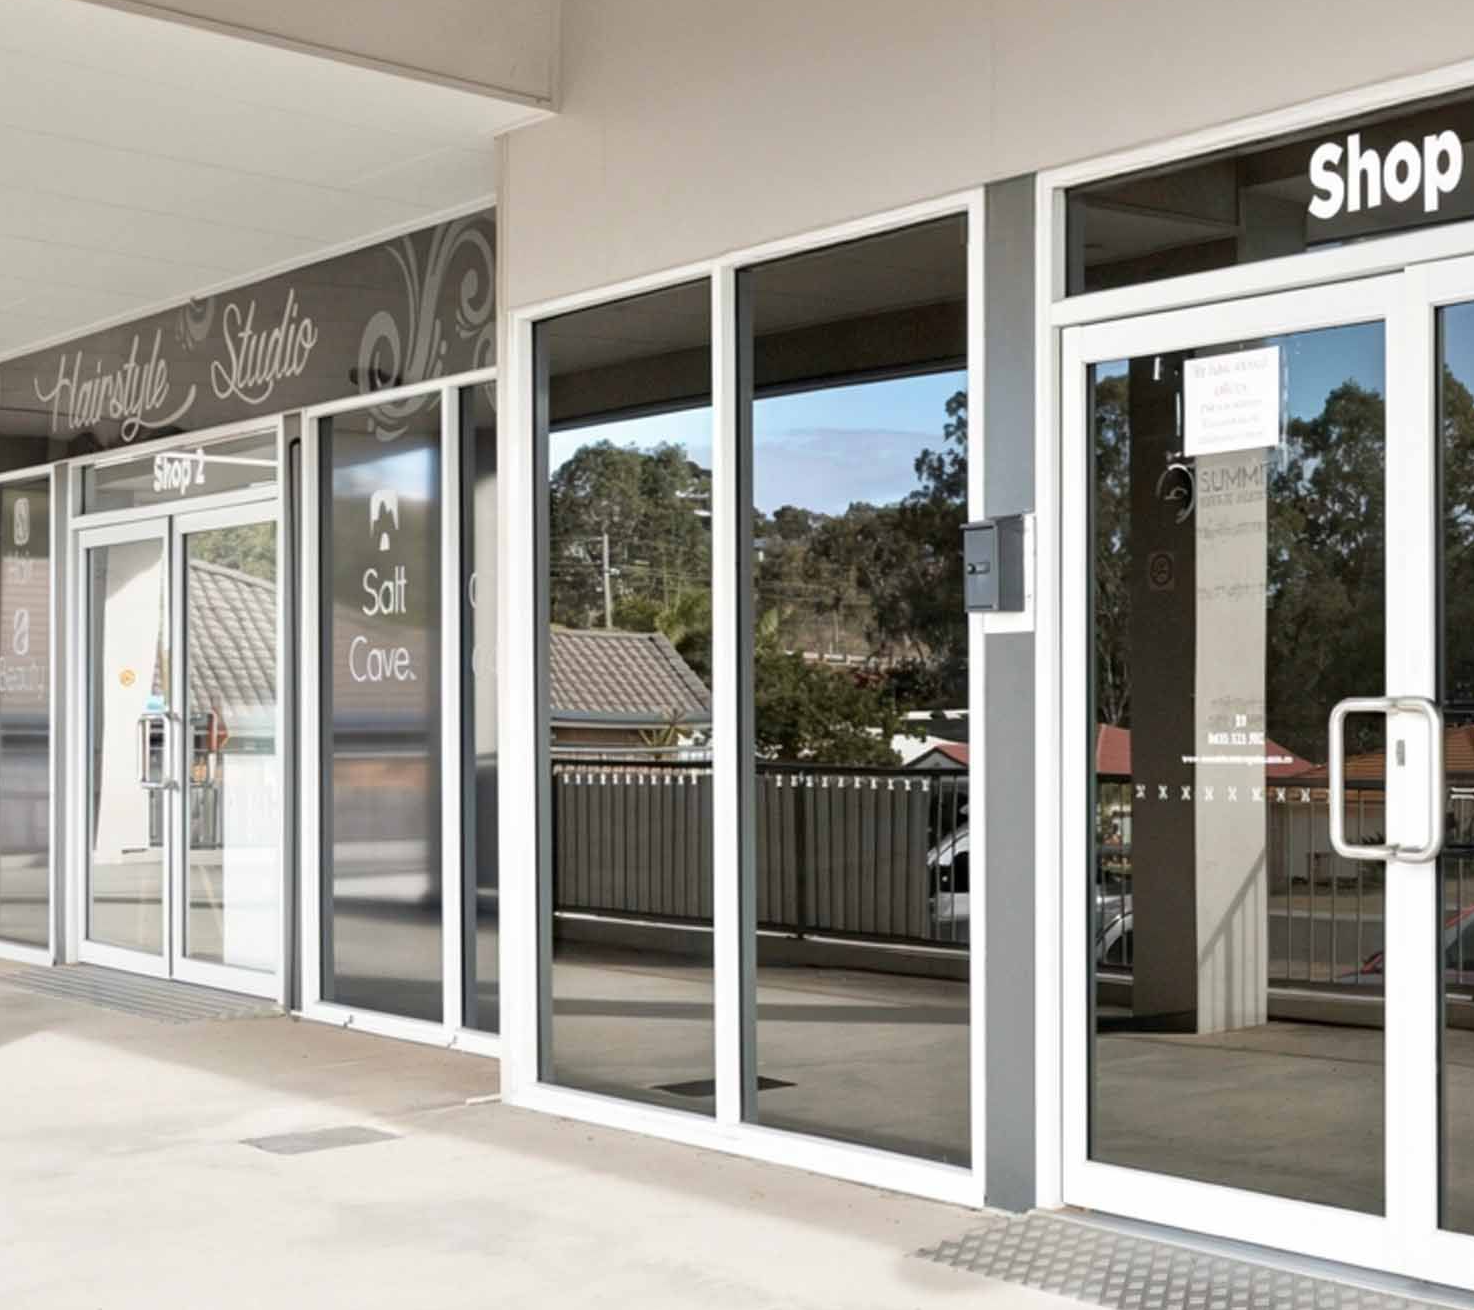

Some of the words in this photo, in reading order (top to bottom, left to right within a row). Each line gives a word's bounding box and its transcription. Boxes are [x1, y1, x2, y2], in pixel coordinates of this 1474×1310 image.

[1308, 131, 1463, 220] Shop
[34, 328, 196, 442] Hairstyle
[211, 288, 318, 404] Studio
[154, 454, 191, 495] Shop
[195, 447, 206, 484] 2
[362, 565, 407, 616] Salt
